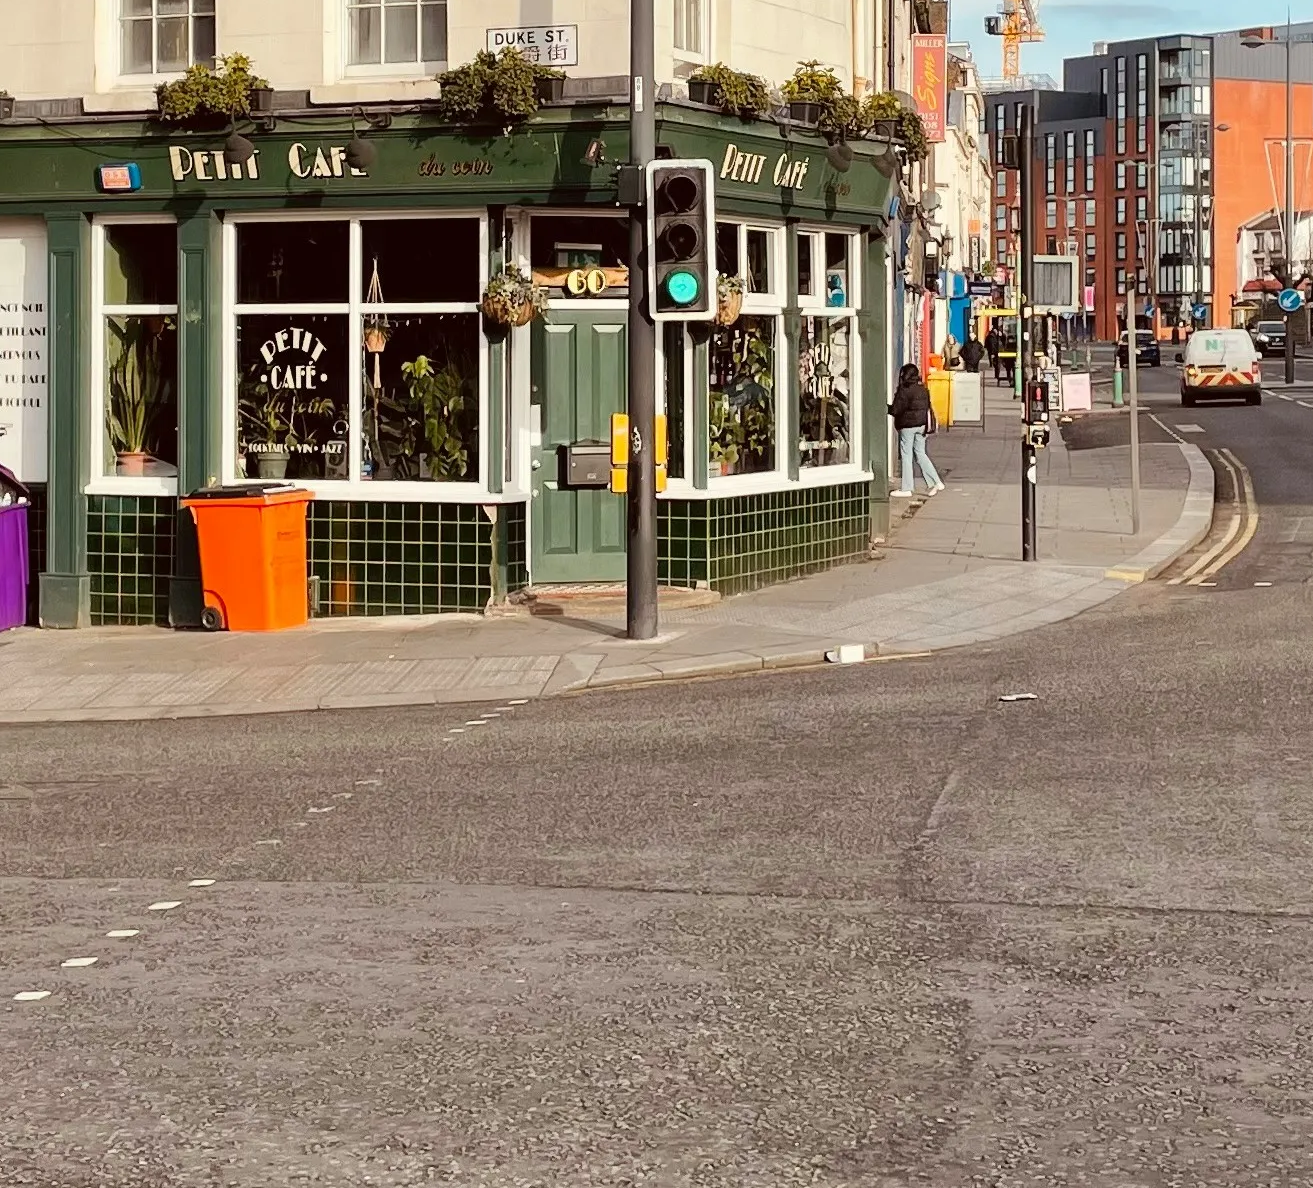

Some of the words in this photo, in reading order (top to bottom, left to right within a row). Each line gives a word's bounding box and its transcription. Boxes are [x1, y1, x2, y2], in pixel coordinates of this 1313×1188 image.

[495, 31, 536, 46] DUKE
[915, 39, 944, 48] MILLER
[288, 142, 368, 178] CAF
[418, 152, 445, 177] du
[451, 157, 494, 177] coin
[567, 269, 606, 294] 60
[260, 327, 327, 365] PETIT
[271, 360, 317, 390] CAFÉ
[296, 443, 313, 453] VIN
[321, 443, 342, 453] JAZZ
